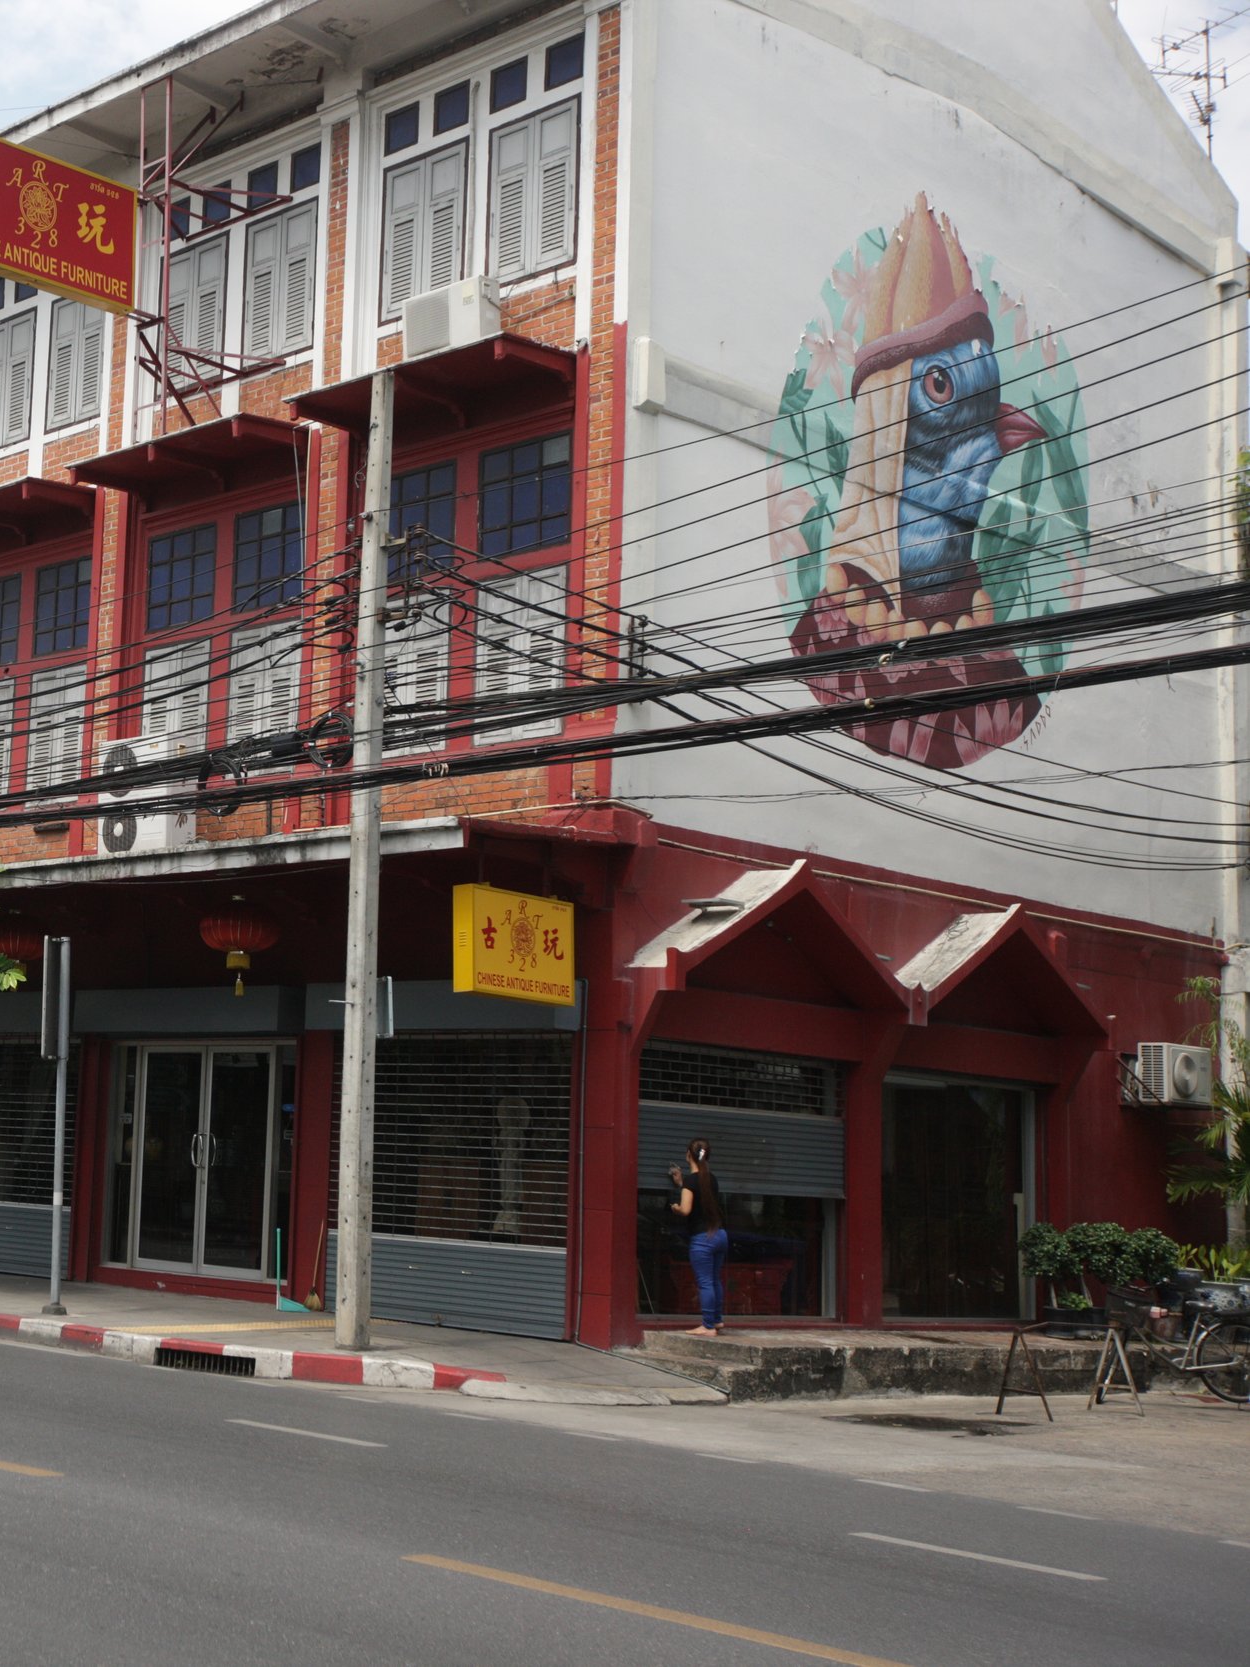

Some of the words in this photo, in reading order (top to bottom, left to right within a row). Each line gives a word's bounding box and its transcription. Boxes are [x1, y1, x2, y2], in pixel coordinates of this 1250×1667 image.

[6, 160, 69, 202] ART
[15, 217, 58, 249] 328
[76, 202, 115, 255] 玩
[4, 242, 58, 276] ANTIQUE
[61, 261, 128, 300] FURNITURE
[501, 900, 544, 930] ART
[508, 949, 537, 972] 328
[477, 971, 505, 987] CHINESE
[506, 976, 534, 992] ANTIQUE
[535, 981, 570, 998] FURNITURE
